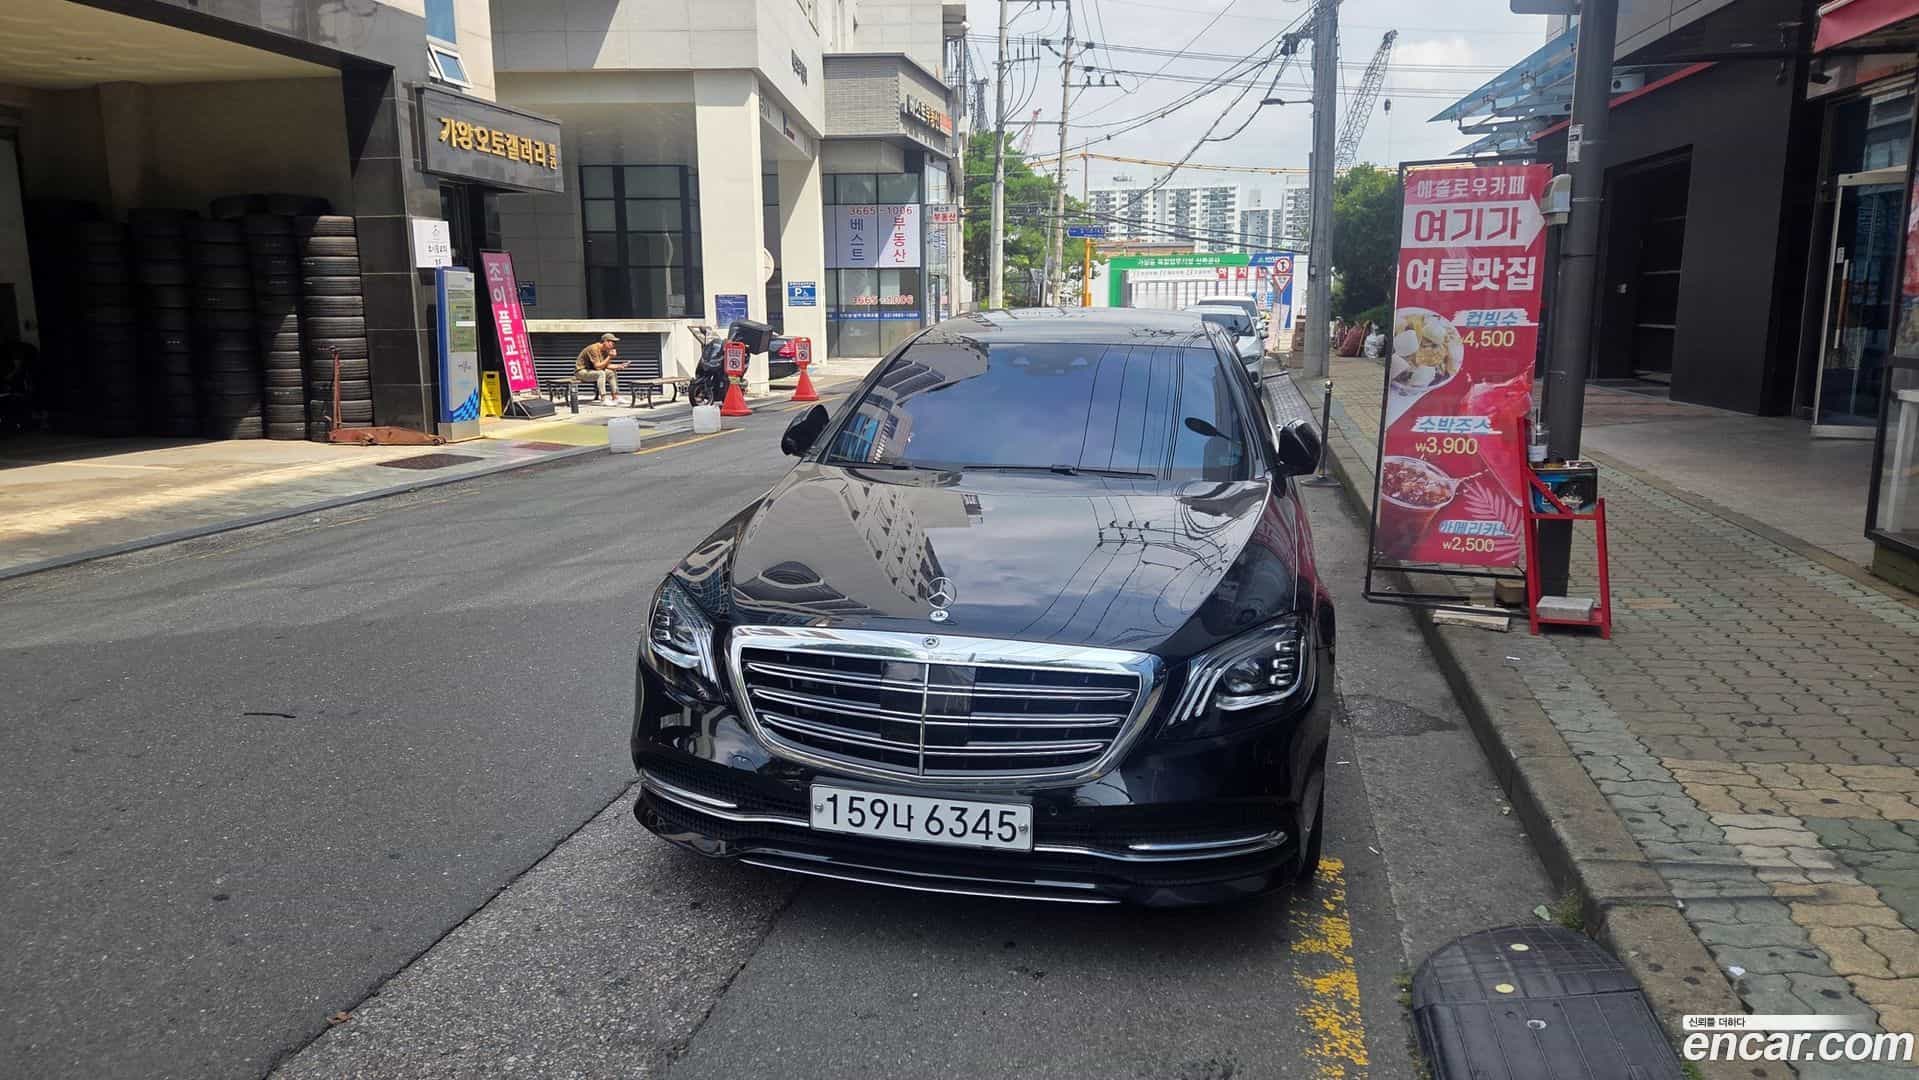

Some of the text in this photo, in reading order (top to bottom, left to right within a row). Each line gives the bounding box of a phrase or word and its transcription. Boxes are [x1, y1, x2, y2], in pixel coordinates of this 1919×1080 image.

[849, 206, 913, 216] 3665-1006
[934, 212, 956, 222] 부동산
[1414, 207, 1522, 242] 여기가
[850, 217, 865, 261] 베스트
[893, 216, 907, 263] 부동산
[1405, 256, 1537, 292] 여름맛집
[794, 287, 803, 297] P
[1466, 311, 1519, 327] 컵빙수
[1461, 330, 1515, 348] 4,500
[826, 793, 1017, 843] 159나 6345
